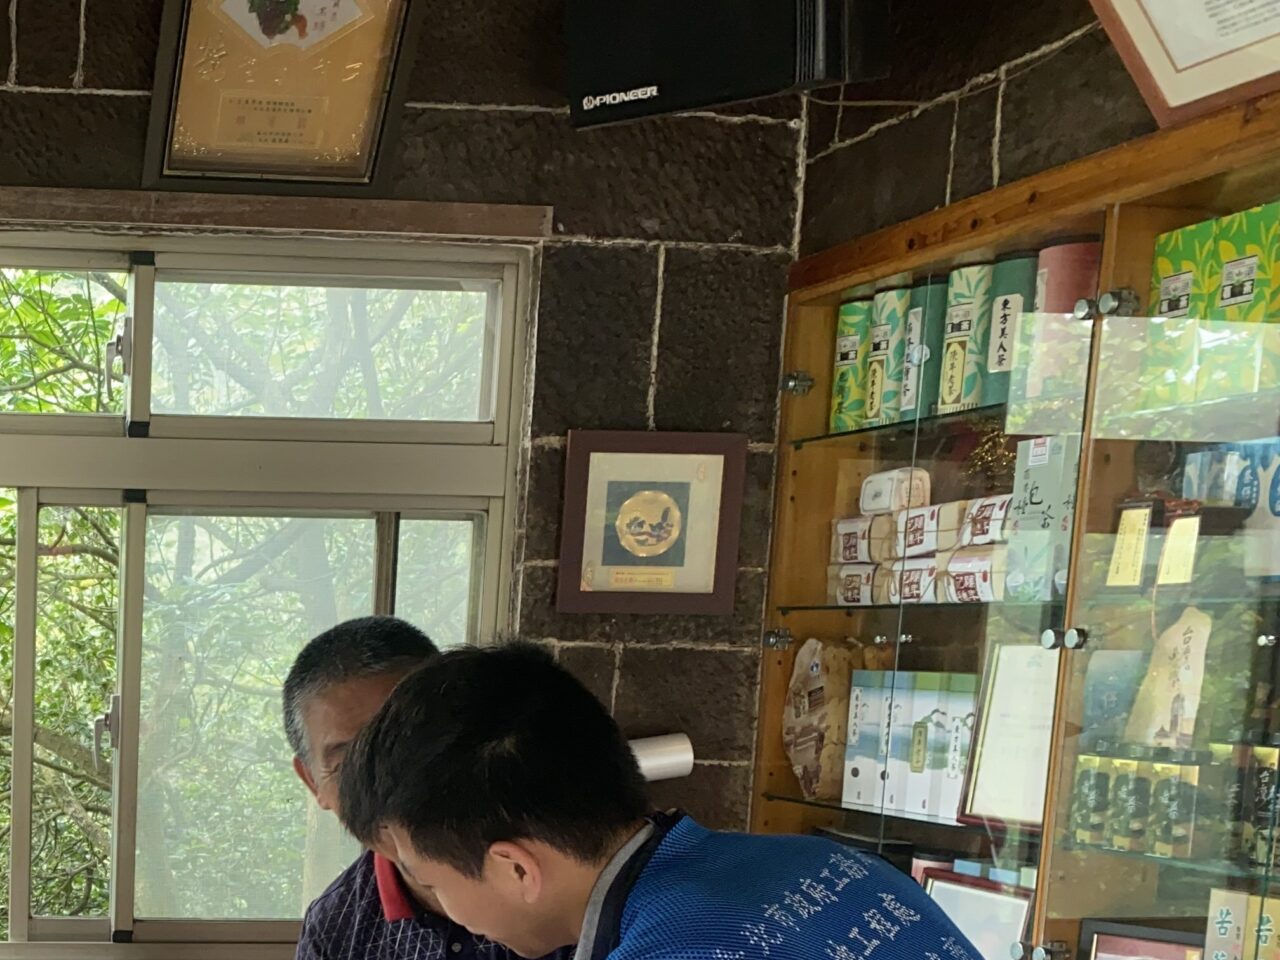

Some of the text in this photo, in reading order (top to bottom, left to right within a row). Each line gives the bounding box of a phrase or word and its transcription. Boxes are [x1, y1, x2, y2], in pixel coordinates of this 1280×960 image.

[595, 85, 659, 107] PIONEER
[995, 298, 1013, 367] 東方美人茶
